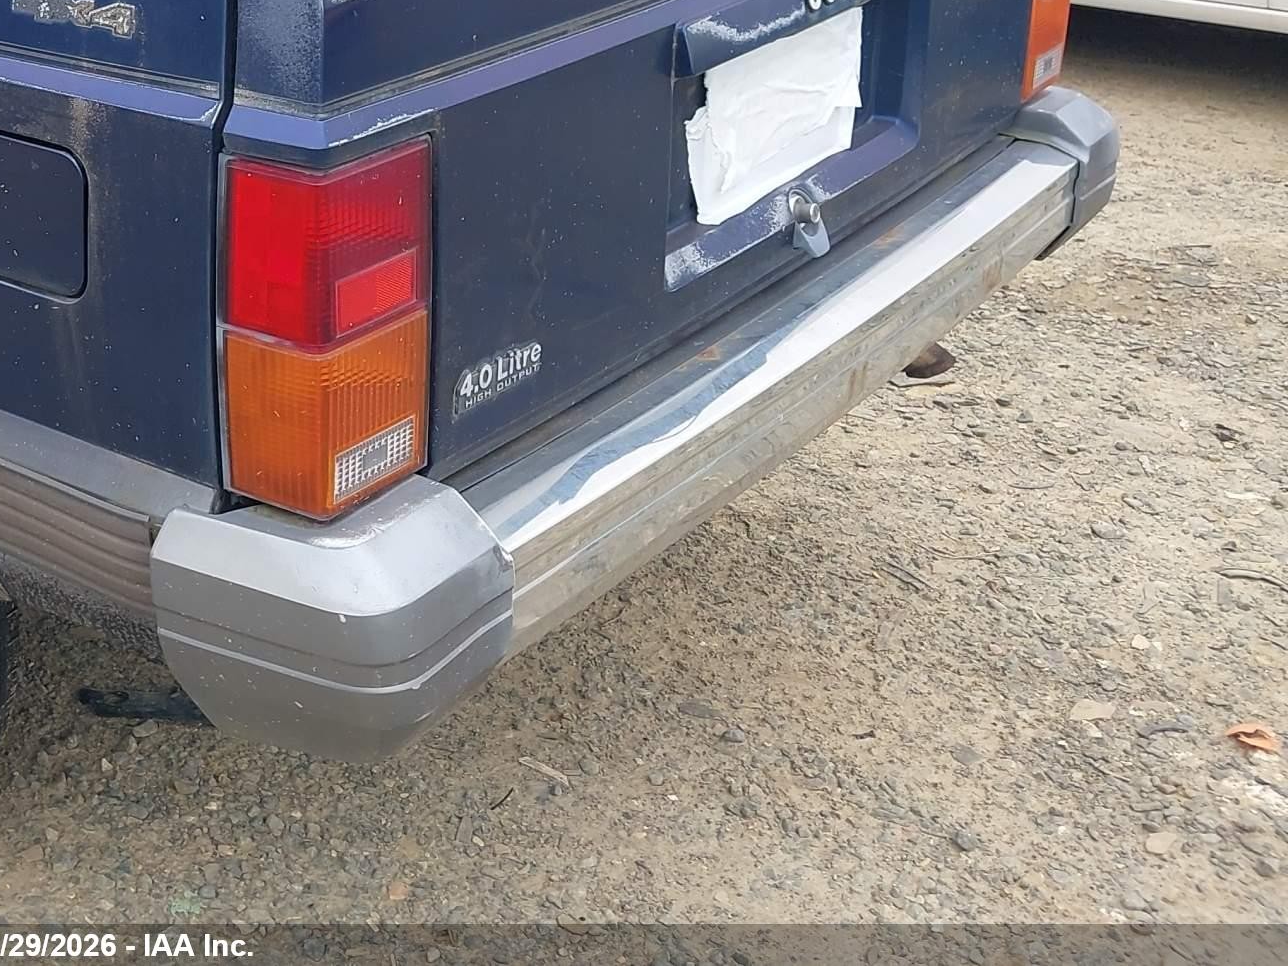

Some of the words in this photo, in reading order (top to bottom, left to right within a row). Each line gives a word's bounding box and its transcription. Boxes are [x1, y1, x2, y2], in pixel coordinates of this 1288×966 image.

[459, 363, 493, 397] 4.0
[496, 342, 542, 381] Litre
[465, 388, 492, 409] HIGH
[496, 362, 542, 392] OUTPUT
